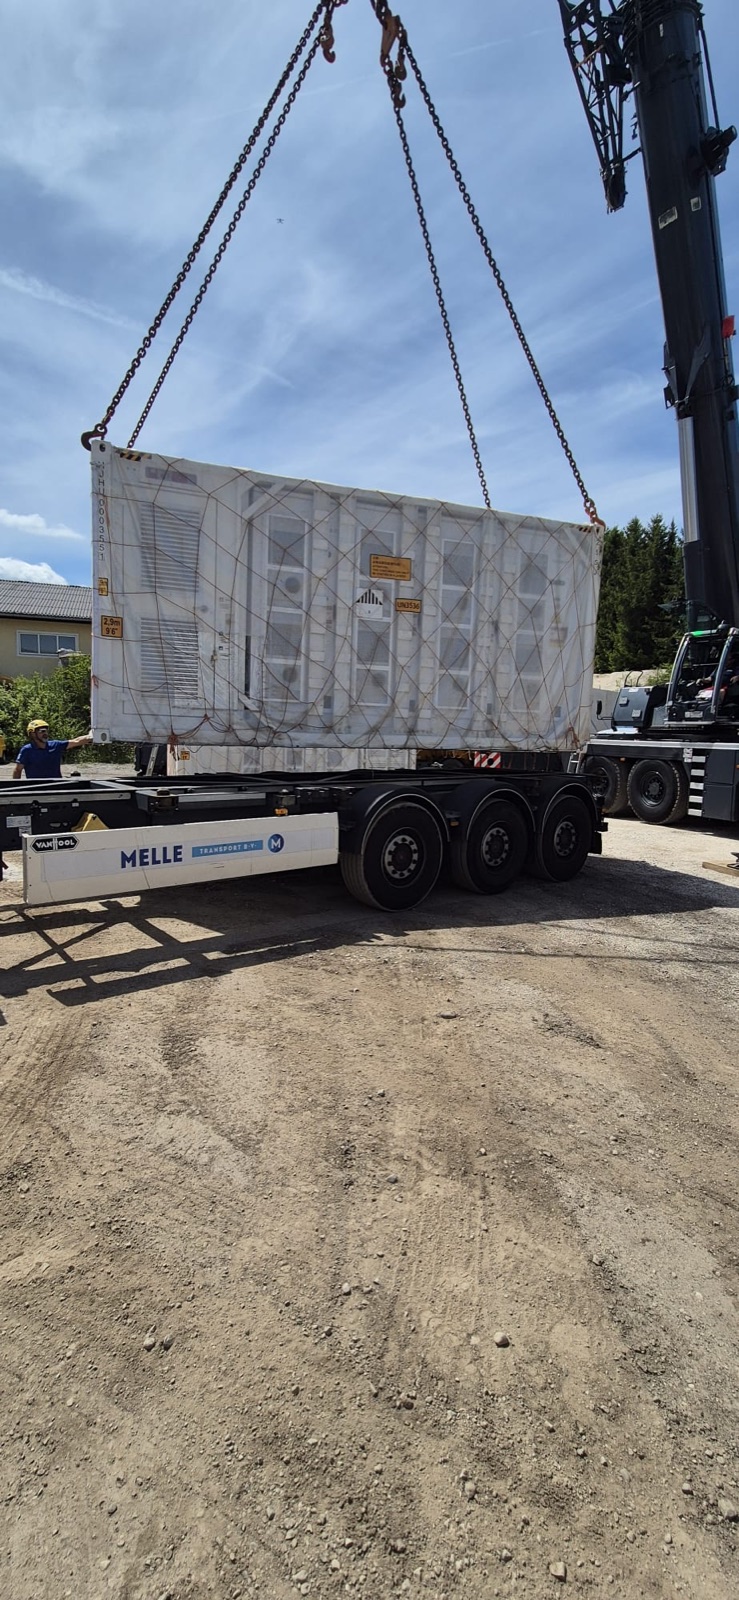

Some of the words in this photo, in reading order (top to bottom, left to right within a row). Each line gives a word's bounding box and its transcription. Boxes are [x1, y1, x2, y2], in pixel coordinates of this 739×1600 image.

[271, 838, 281, 849] M
[121, 845, 183, 869] MELLE
[200, 845, 241, 854] TRANSPORT
